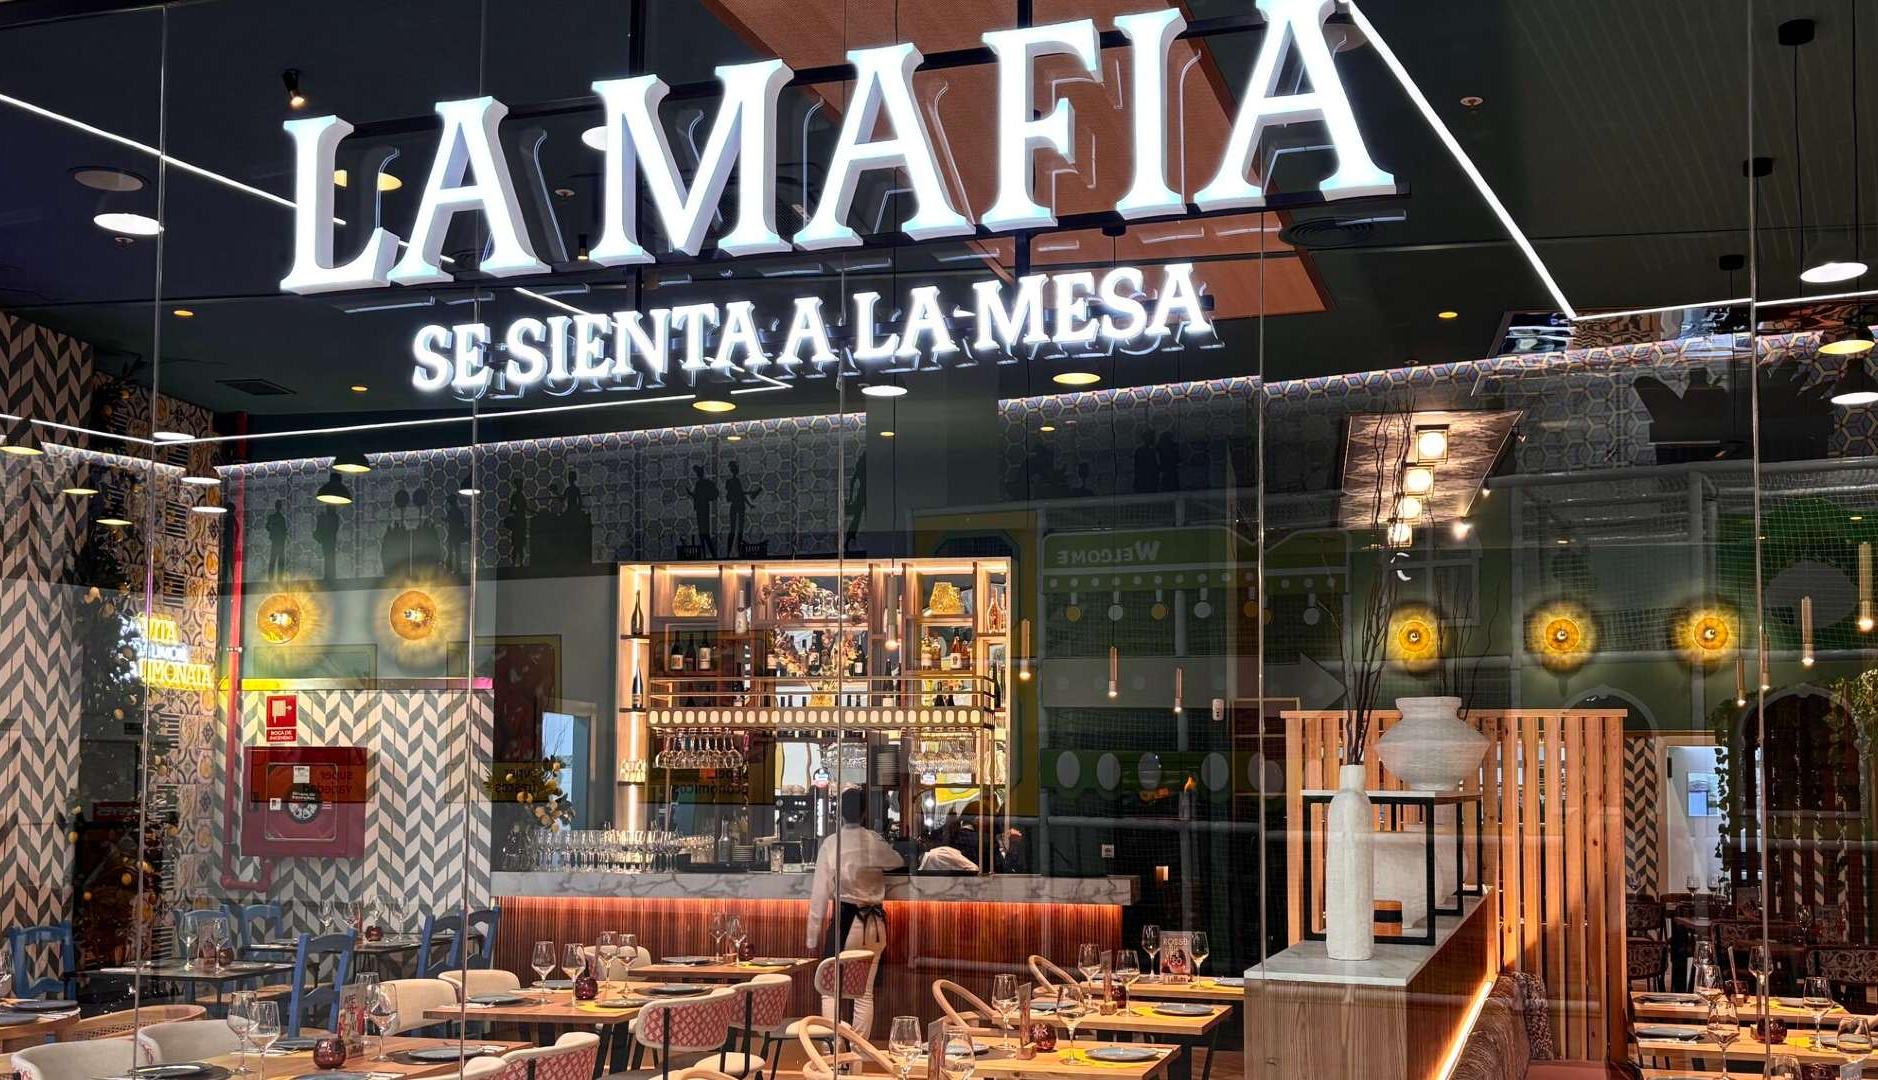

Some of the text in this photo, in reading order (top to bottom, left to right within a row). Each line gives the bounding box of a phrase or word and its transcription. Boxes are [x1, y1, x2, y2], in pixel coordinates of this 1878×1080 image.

[280, 0, 1397, 294] LA MAFIA
[411, 261, 1212, 391] SE SIENTA A LA MESA
